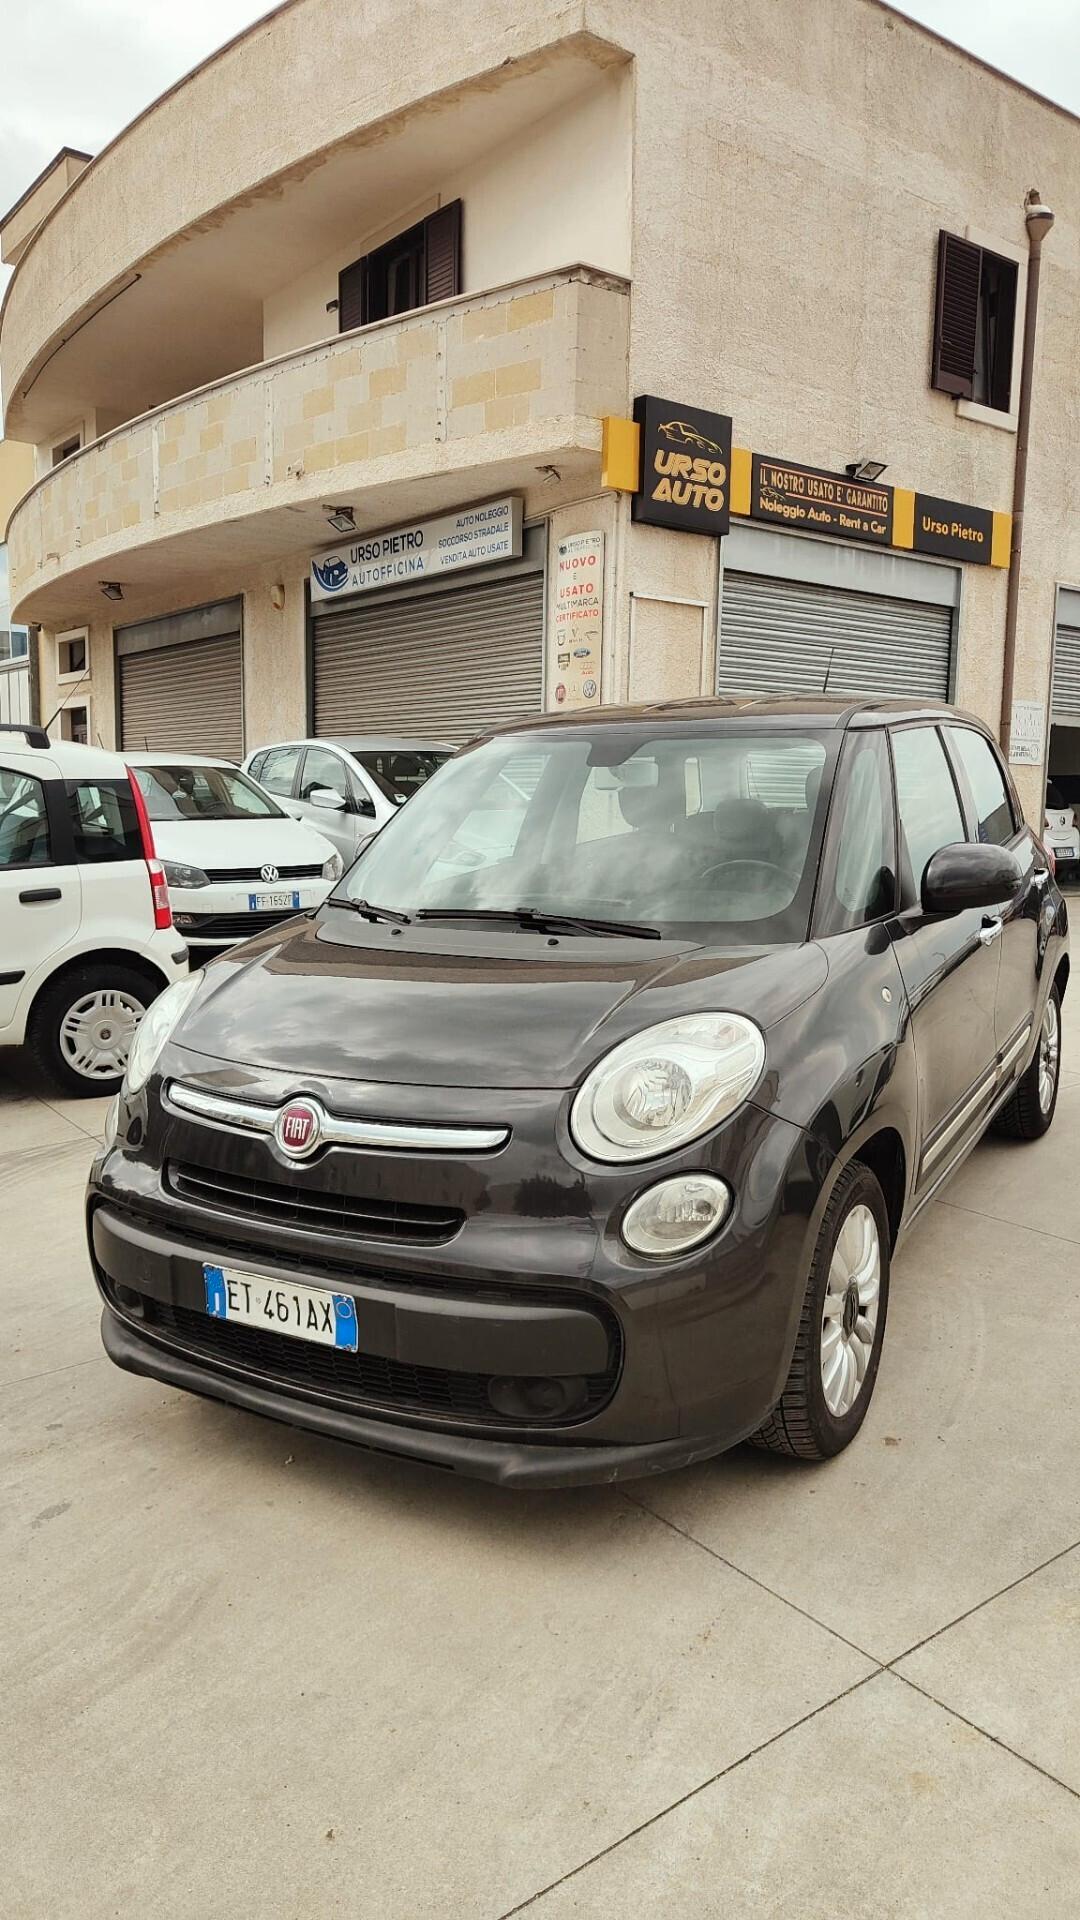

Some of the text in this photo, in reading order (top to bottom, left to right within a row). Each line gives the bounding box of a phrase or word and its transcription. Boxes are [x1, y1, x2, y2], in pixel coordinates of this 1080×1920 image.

[654, 448, 726, 486] URSO
[651, 477, 724, 511] AUTO
[760, 468, 767, 485] IL
[771, 470, 804, 493] NOSTRO
[807, 479, 833, 500] USATO
[846, 488, 888, 512] GARANTITO
[456, 505, 509, 528] AUTO NOLEGGIO
[760, 497, 805, 518] Noleggio
[807, 507, 831, 522] Auto
[839, 513, 861, 529] Rent
[862, 522, 868, 531] a
[870, 521, 886, 534] Car
[438, 522, 509, 549] SOCCORSO STRADALE
[922, 516, 984, 543] Urso Pietro
[351, 530, 424, 564] URSO PIETRO
[441, 540, 509, 565] VENDITA AUTO USATE
[352, 556, 424, 587] AUTOFFICINA
[560, 555, 596, 572] NUOVO
[556, 597, 599, 610] MULTIMARCA
[560, 583, 594, 598] USATO
[556, 609, 599, 623] CERTIFICATO
[285, 1116, 310, 1140] FIAT
